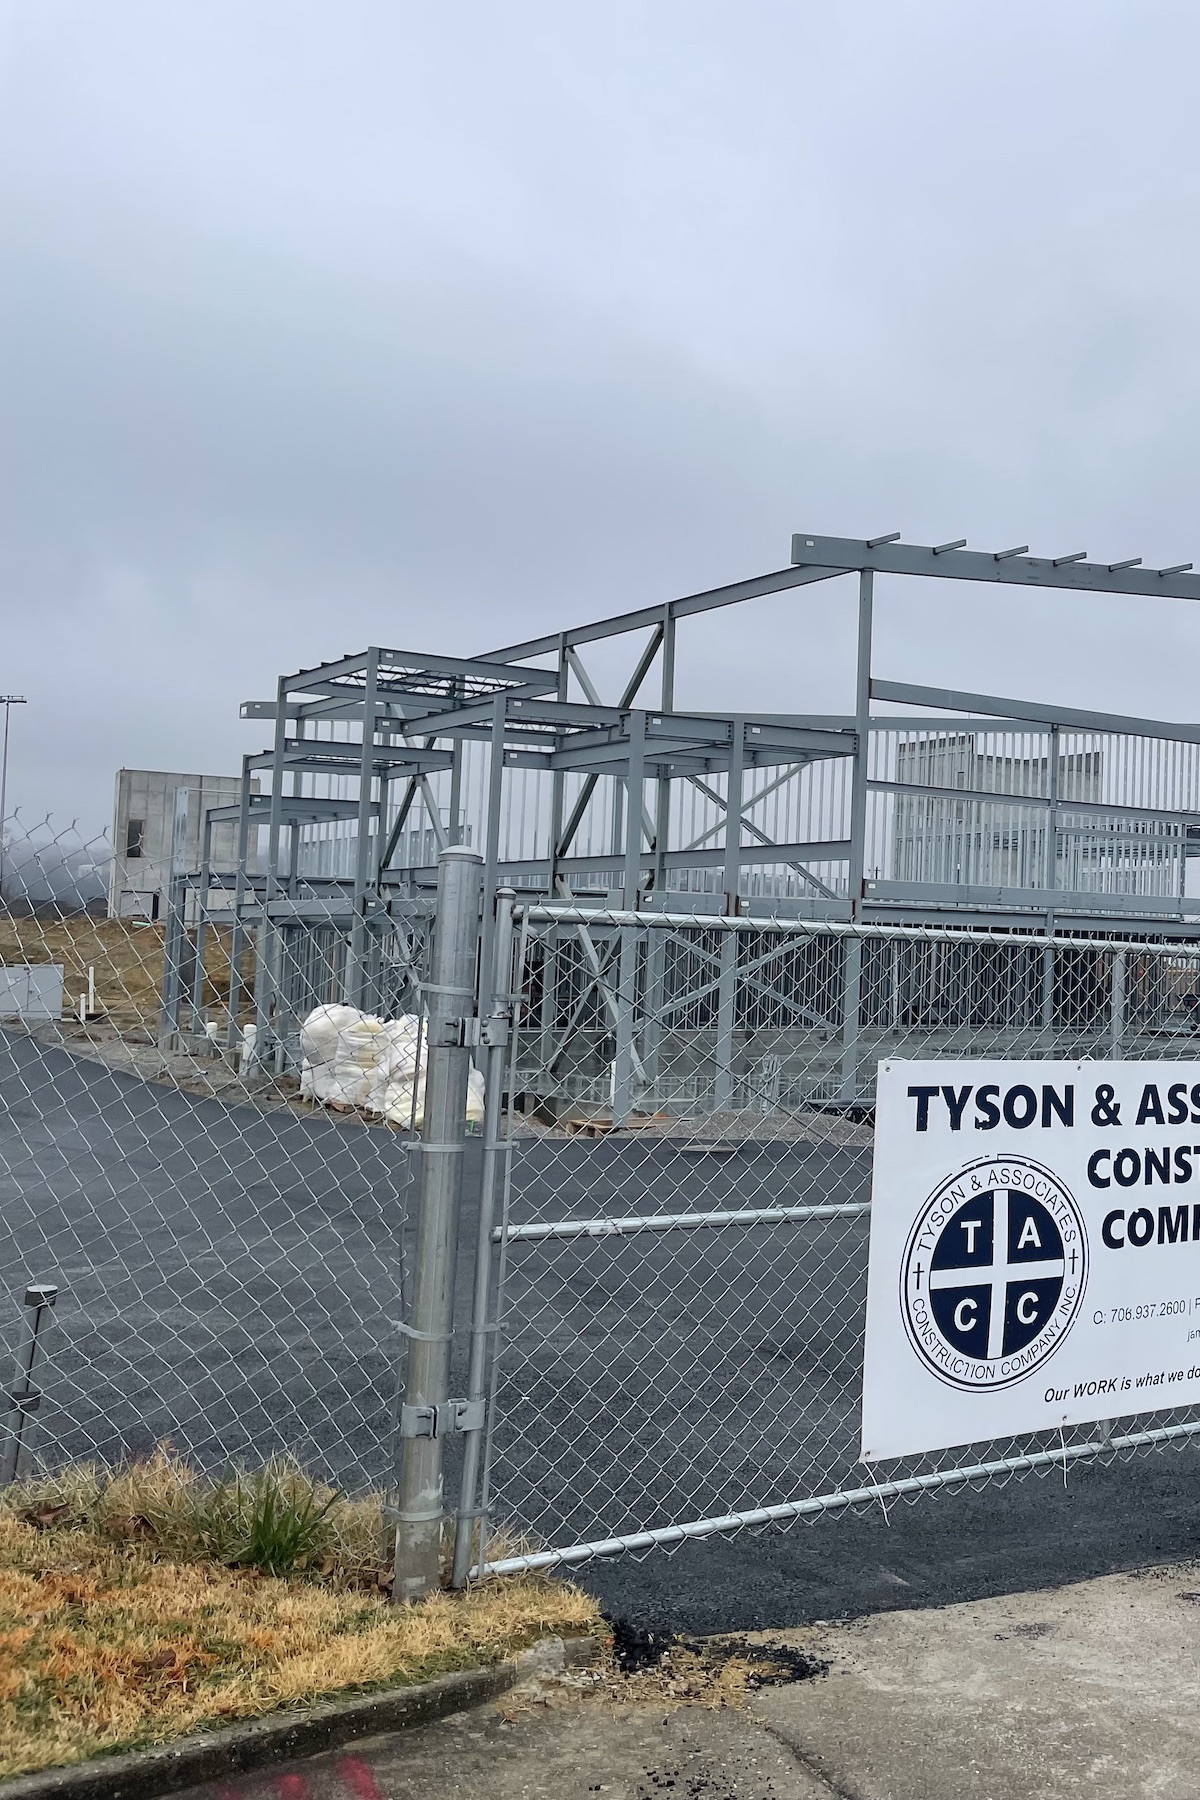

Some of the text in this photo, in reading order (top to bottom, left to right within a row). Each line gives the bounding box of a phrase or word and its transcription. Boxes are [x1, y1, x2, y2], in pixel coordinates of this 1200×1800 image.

[907, 1084, 1074, 1131] TYSON
[1090, 1084, 1122, 1127] &
[917, 1168, 1076, 1251] TYSON & ASSOCIATES
[960, 1216, 1042, 1253] T A
[912, 1283, 1078, 1379] CONSTRUCTION COMPANY INC.
[954, 1291, 1039, 1332] C C
[1111, 1300, 1186, 1322] 706.937.2600
[1044, 1387, 1070, 1403] Our
[1073, 1377, 1118, 1398] WORK
[1120, 1377, 1132, 1391] is
[1135, 1372, 1164, 1388] what
[1167, 1370, 1183, 1383] we
